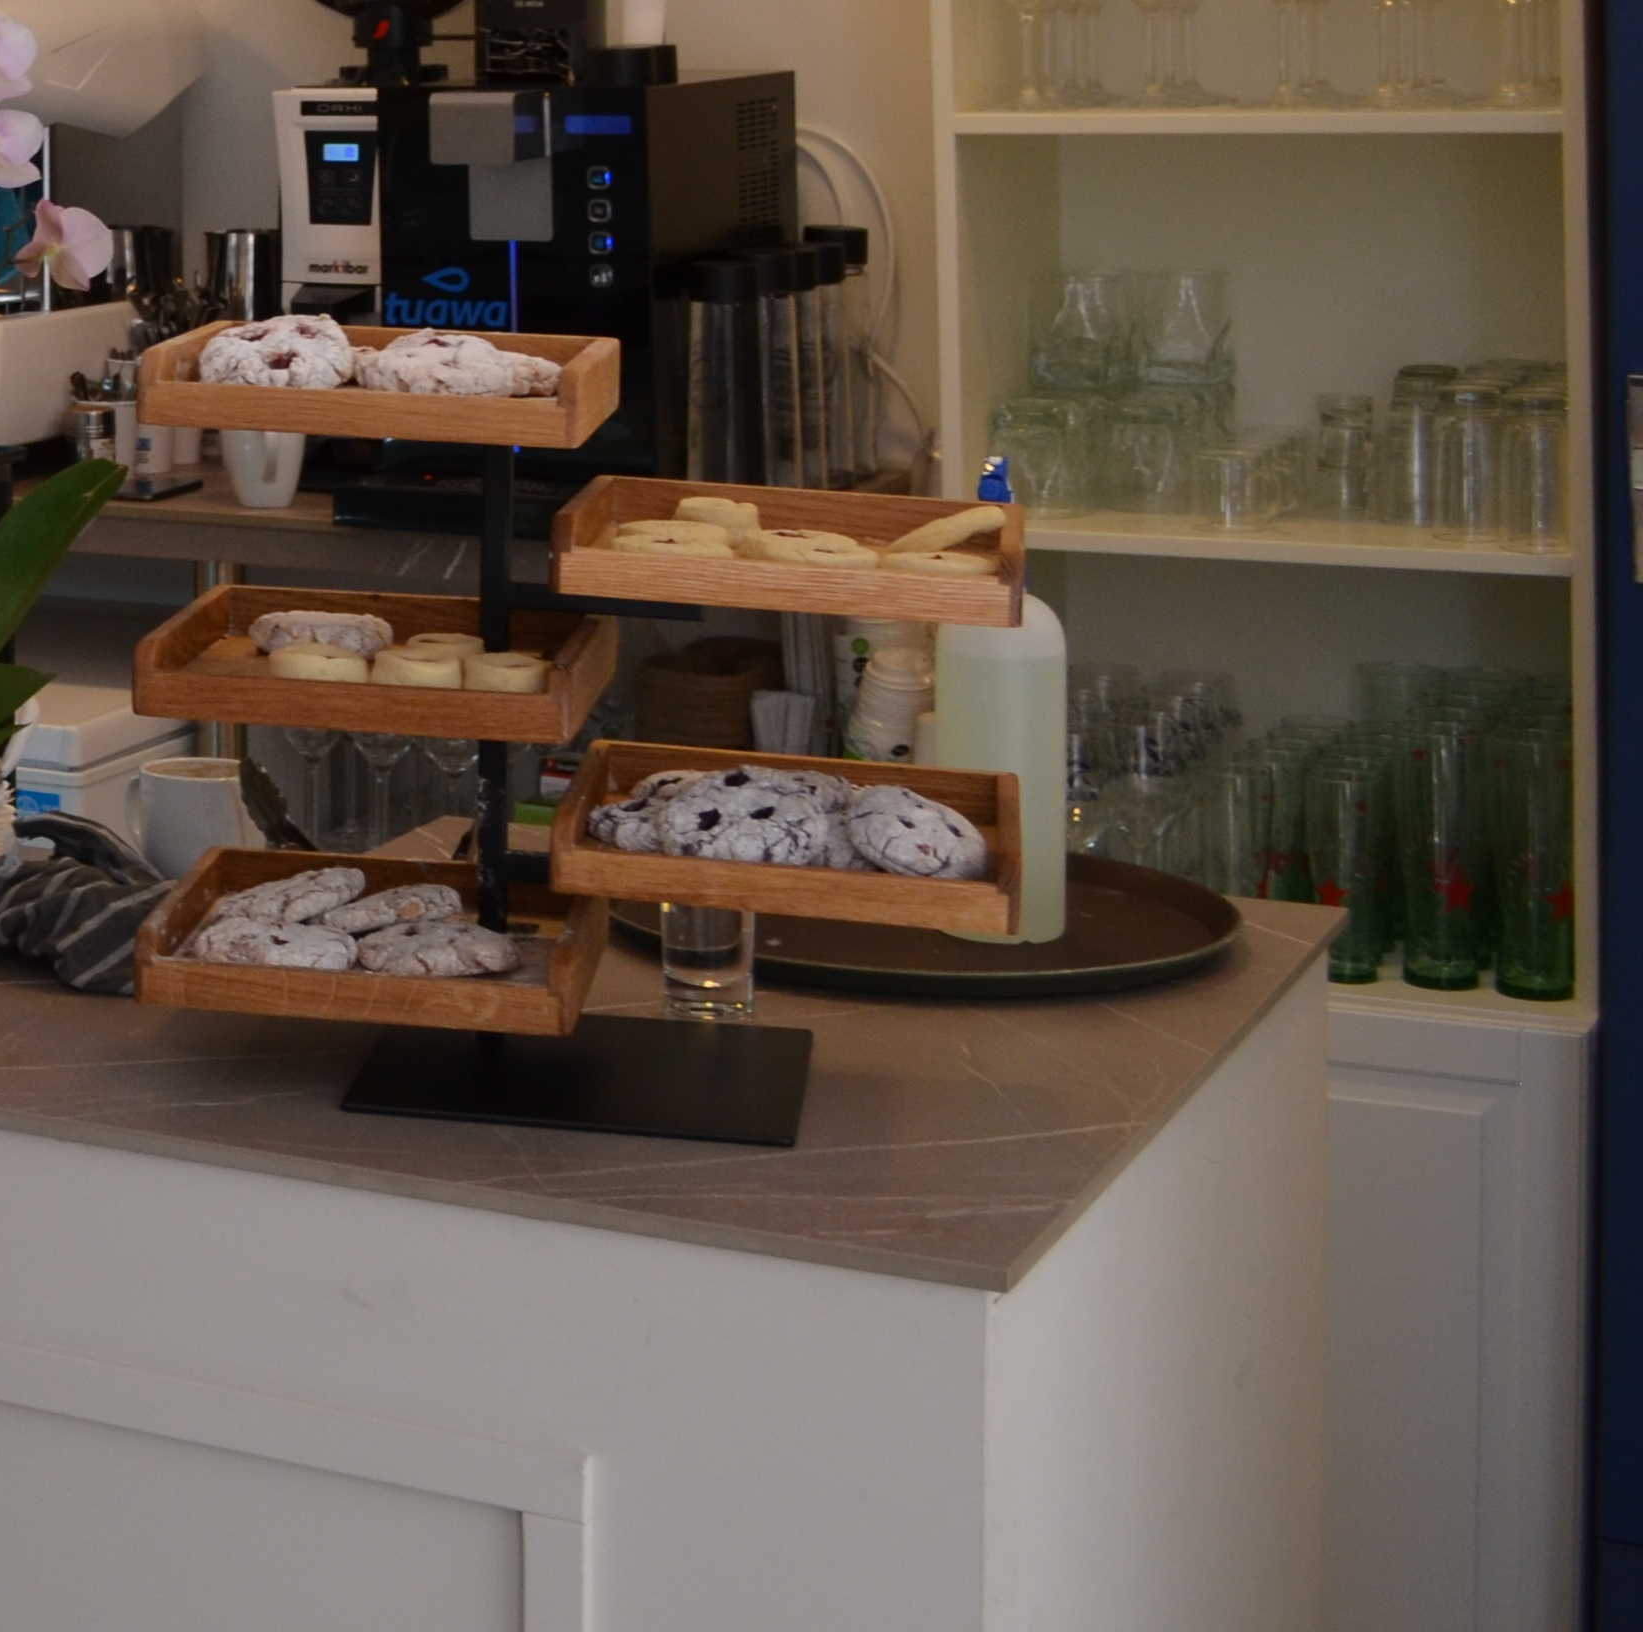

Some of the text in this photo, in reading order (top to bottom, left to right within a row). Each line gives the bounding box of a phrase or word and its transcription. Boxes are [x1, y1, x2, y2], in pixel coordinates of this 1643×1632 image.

[315, 102, 363, 114] ORHI
[308, 260, 369, 275] markibar
[384, 291, 509, 327] tuawa
